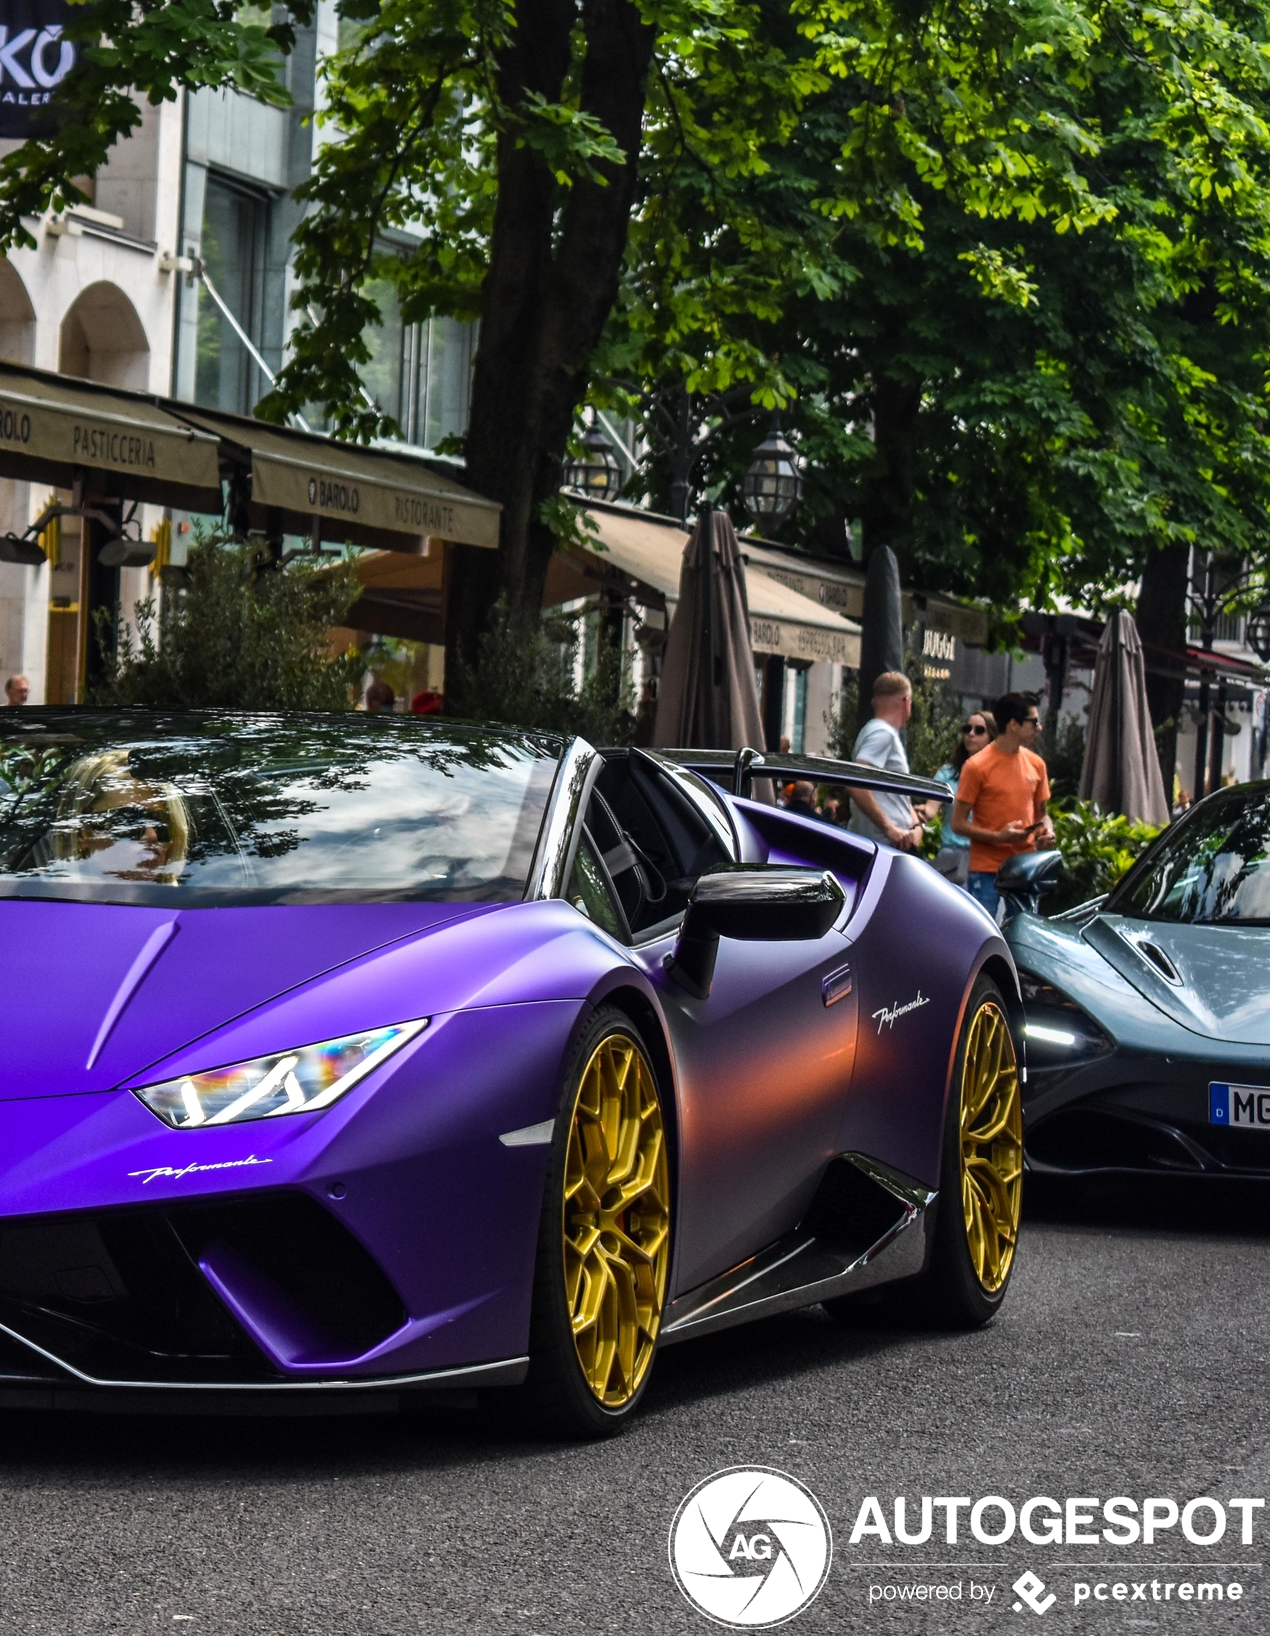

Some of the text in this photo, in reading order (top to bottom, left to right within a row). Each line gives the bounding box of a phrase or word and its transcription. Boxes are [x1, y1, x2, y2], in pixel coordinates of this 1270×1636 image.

[73, 425, 155, 467] PASTICCERIA
[319, 480, 453, 532] BAROLO RISTORANTE
[871, 989, 930, 1035] Performante
[1215, 1091, 1270, 1124] D MG
[127, 1154, 273, 1184] Performante
